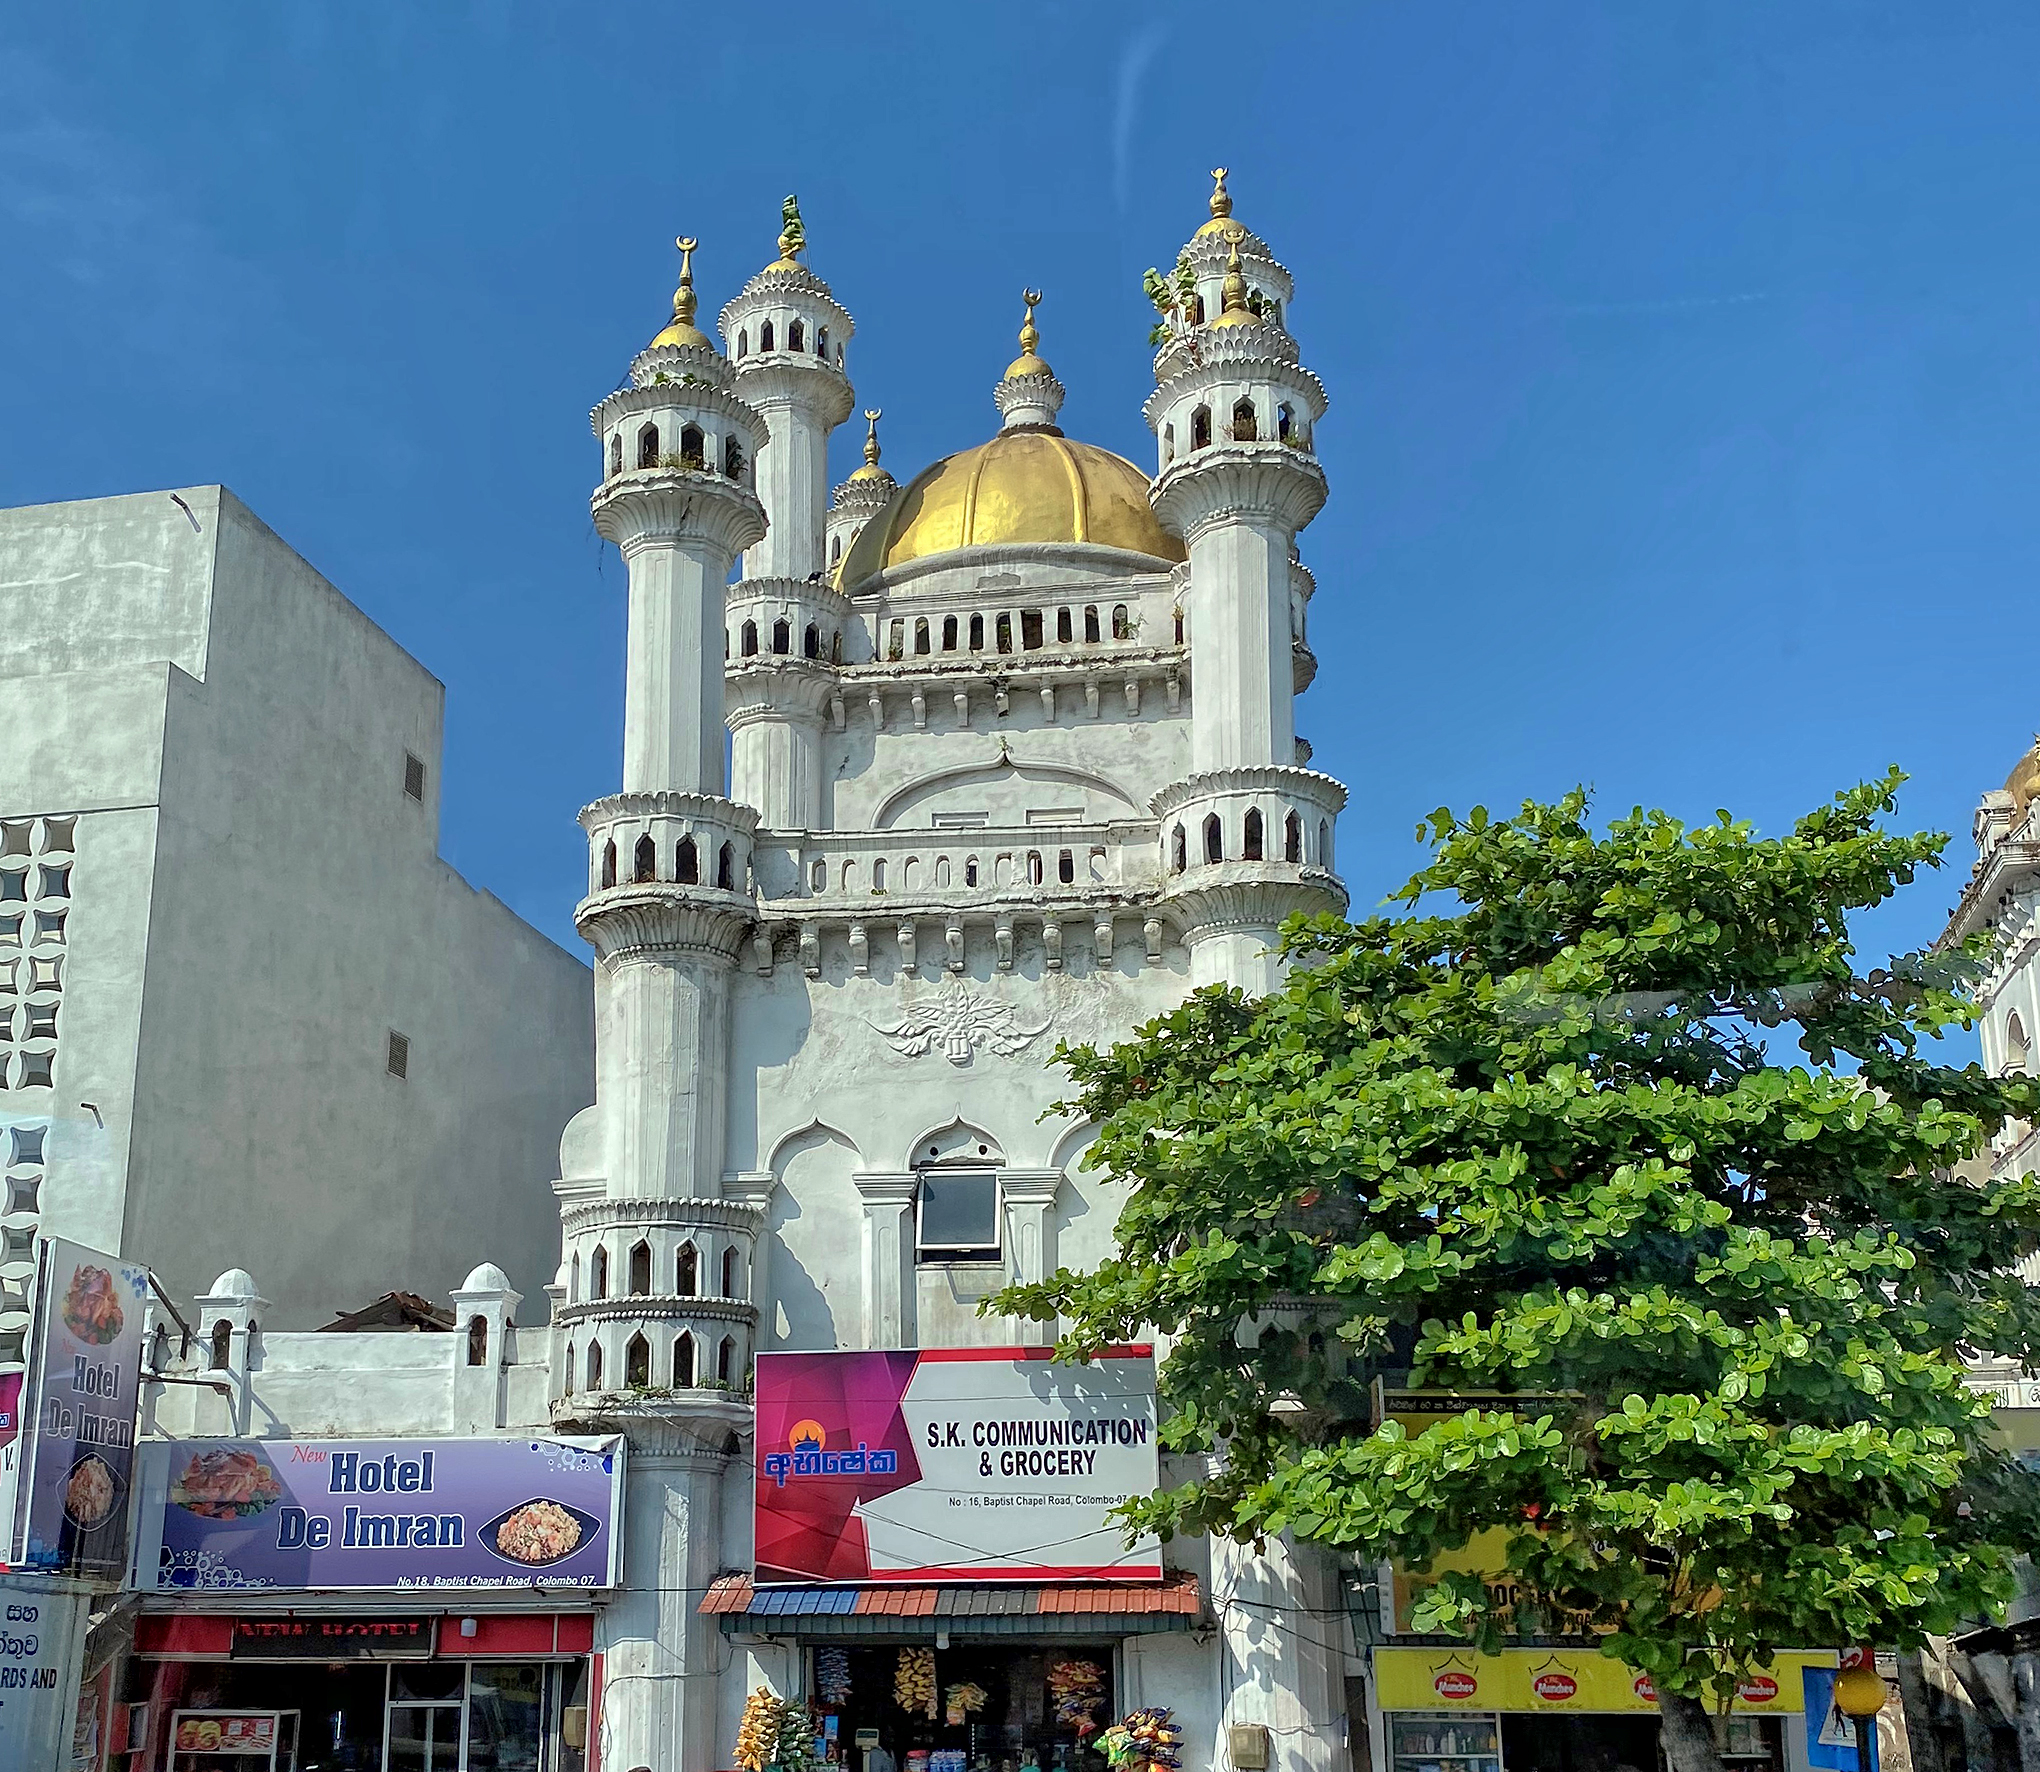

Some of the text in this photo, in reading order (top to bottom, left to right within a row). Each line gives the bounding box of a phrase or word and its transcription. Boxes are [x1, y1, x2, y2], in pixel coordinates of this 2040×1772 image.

[72, 1354, 121, 1400] Hotel
[46, 1397, 131, 1449] De Imran
[927, 1418, 1147, 1448] S.K. COMMUNICATION
[291, 1445, 435, 1495] New Hotel
[979, 1449, 1096, 1476] & GROCERY
[949, 1497, 961, 1507] No
[969, 1497, 981, 1507] 16,
[983, 1496, 1014, 1508] Baptist
[1016, 1496, 1046, 1508] Chapel
[1048, 1495, 1073, 1507] Road,
[276, 1505, 465, 1551] De Imran
[434, 1576, 468, 1588] Baptist
[470, 1576, 503, 1588] Chapel
[506, 1576, 533, 1588] Road,
[536, 1575, 578, 1587] Colombo
[581, 1576, 598, 1586] 07.
[6, 1604, 39, 1623] සහ
[30, 1668, 57, 1689] AND
